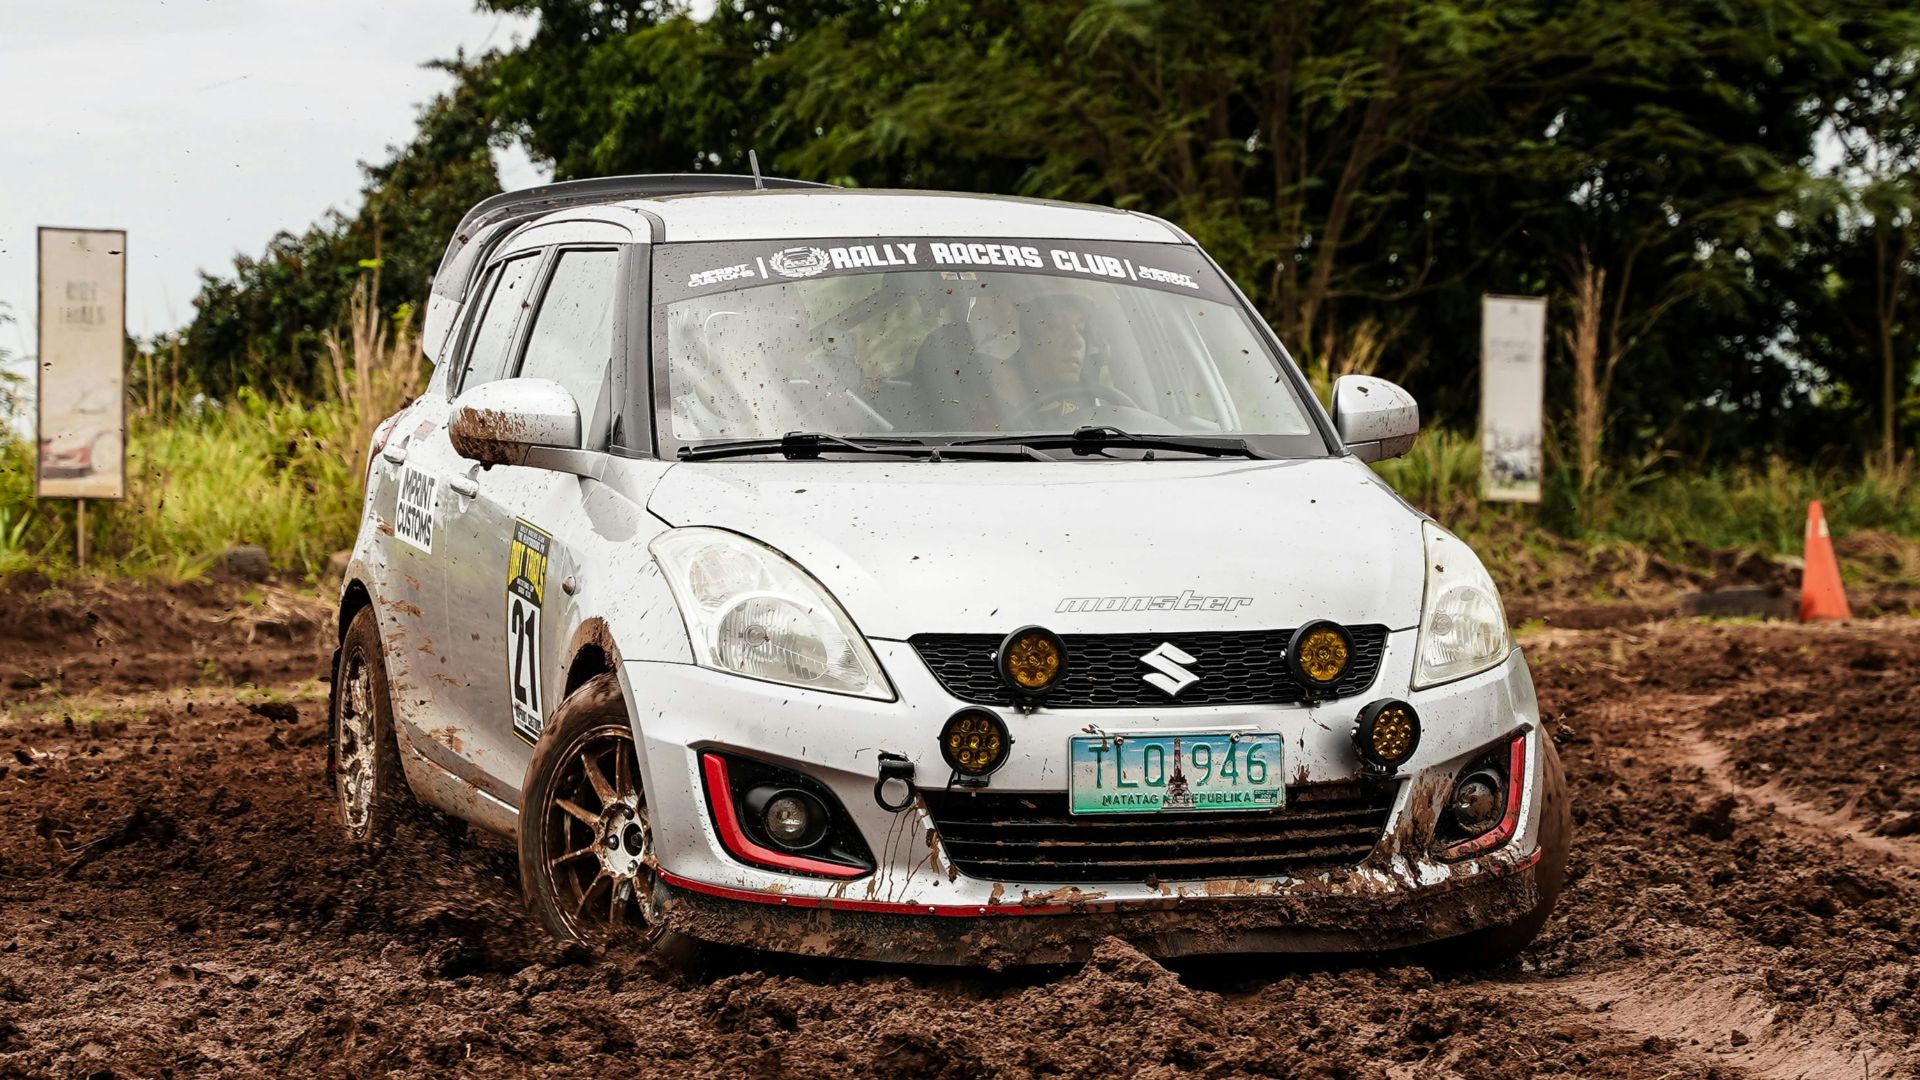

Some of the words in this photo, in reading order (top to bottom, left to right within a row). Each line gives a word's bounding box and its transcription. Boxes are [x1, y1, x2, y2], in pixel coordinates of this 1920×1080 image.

[690, 263, 750, 281] IMPRINT
[828, 243, 917, 269] RALLY
[930, 243, 1044, 268] RACERS
[1050, 249, 1127, 278] CLUB
[687, 270, 756, 288] CUSTOMS
[402, 467, 436, 511] IMPRINT
[397, 501, 433, 547] CUSTOMS
[1054, 589, 1254, 613] monster
[512, 598, 539, 713] 21
[1192, 741, 1268, 787] 946
[1103, 793, 1159, 806] MATATAG
